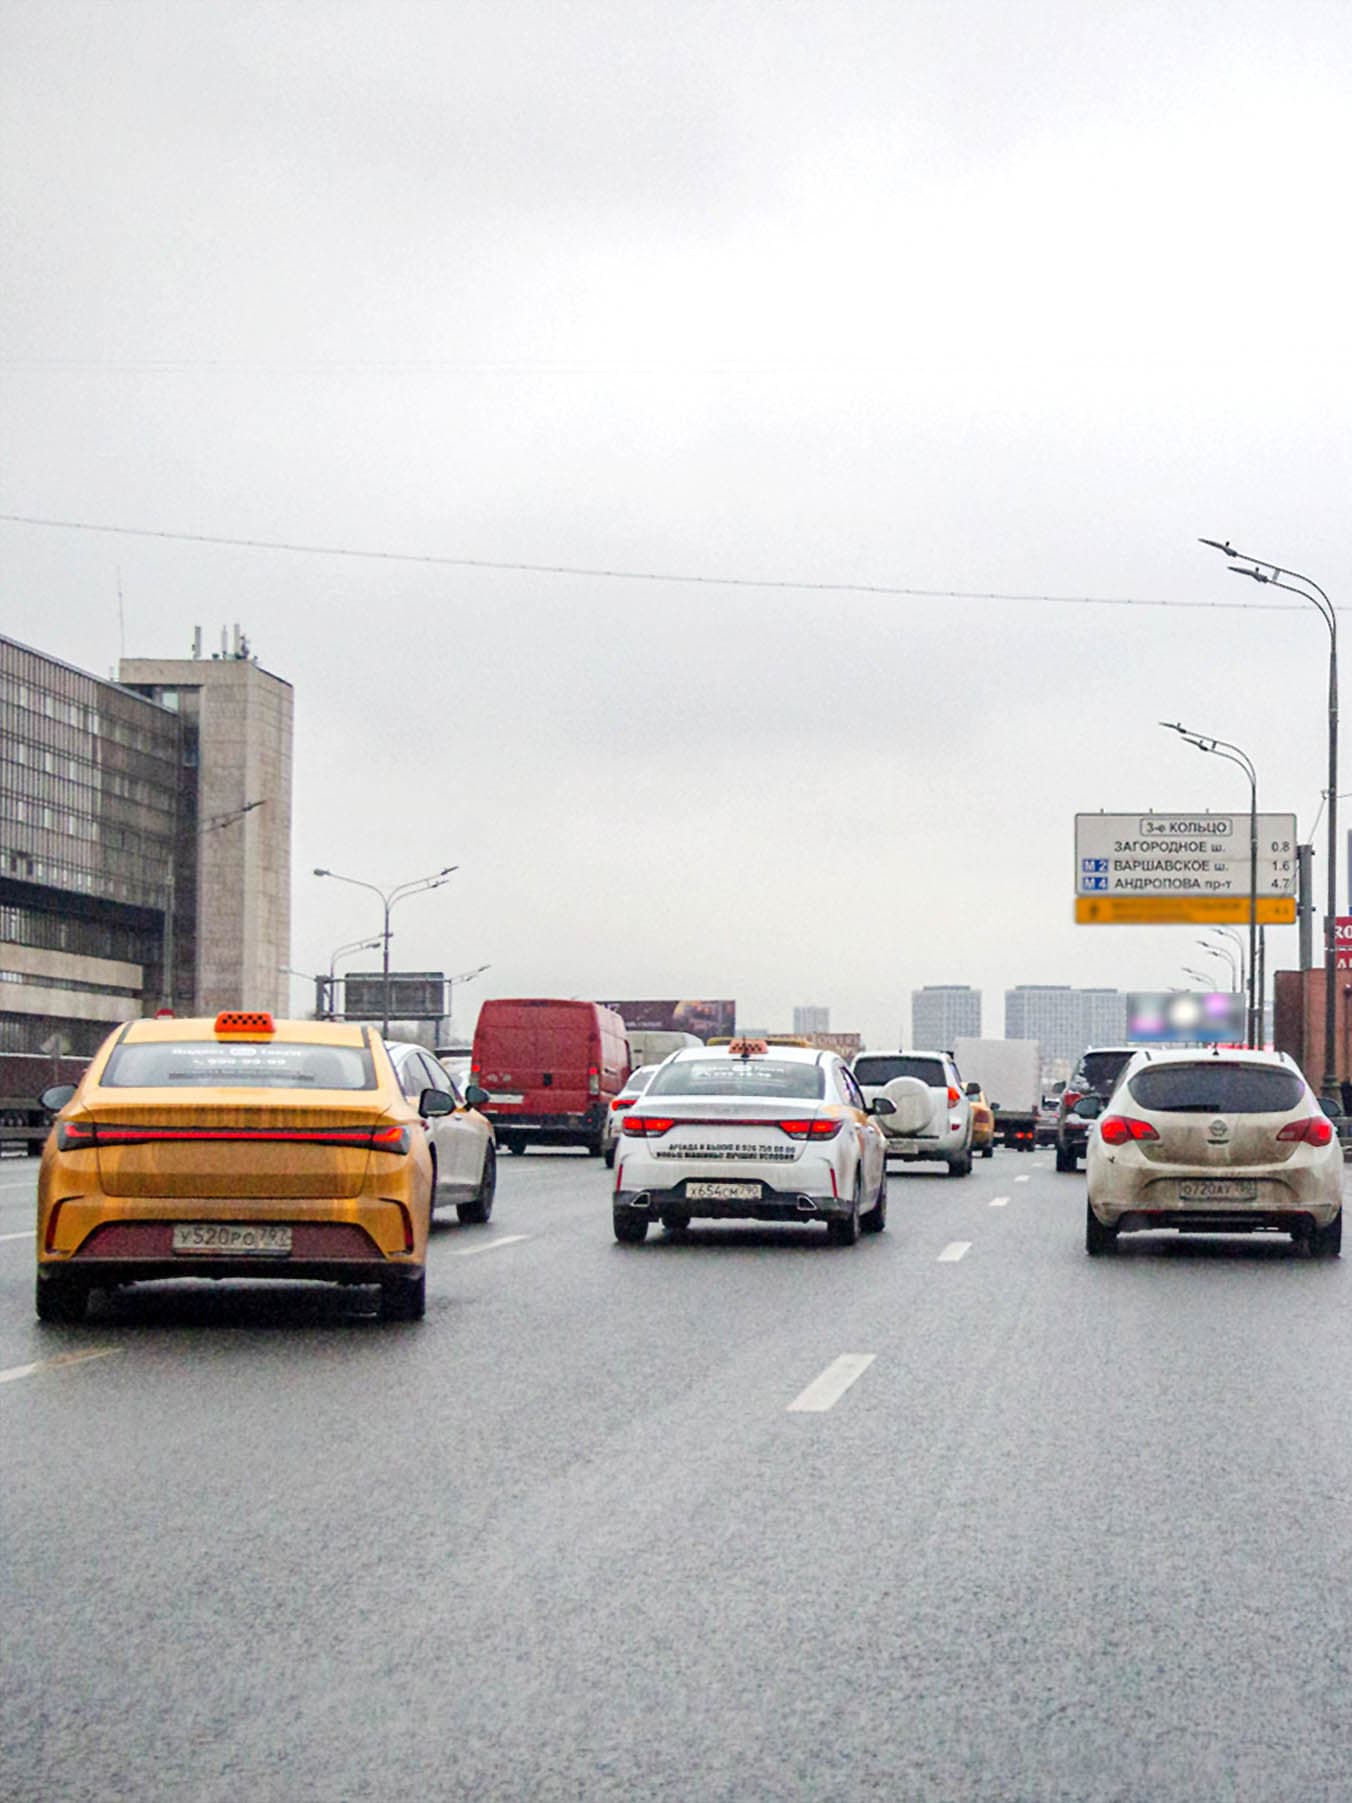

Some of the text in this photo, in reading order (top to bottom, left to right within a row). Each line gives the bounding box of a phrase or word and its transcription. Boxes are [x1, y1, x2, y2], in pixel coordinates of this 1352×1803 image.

[1169, 822, 1227, 834] КОЛЬЦО
[1114, 840, 1226, 854] ЗАГОРОДНОЕ ш.
[1271, 841, 1290, 853] 0.8
[1114, 860, 1229, 872] ВАРШАВСКОЕ ш.
[1272, 860, 1290, 871] 1.6
[1114, 878, 1232, 891] АНДРОПОВА пр-т
[1271, 878, 1290, 889] 4.7
[180, 1227, 256, 1246] У520РО
